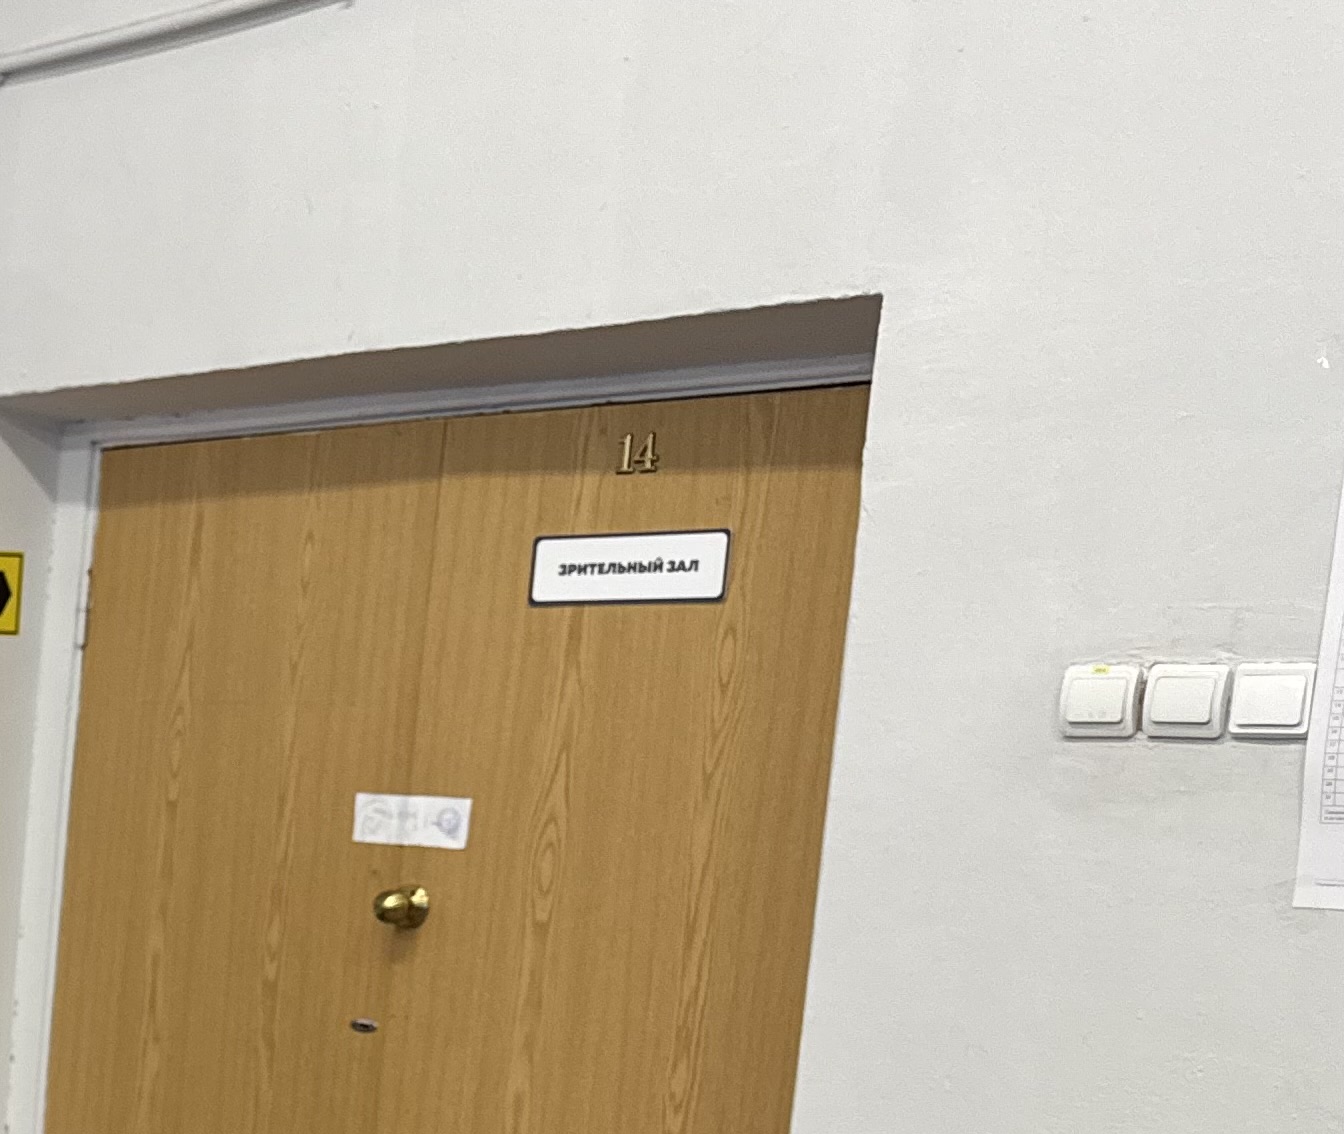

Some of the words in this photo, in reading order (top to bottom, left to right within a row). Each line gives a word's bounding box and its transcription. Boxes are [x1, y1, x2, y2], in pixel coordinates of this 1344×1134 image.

[615, 432, 659, 474] 14
[558, 557, 663, 577] ЗРИТЕЛЬНЫЙ
[667, 559, 700, 574] ЗАЛ
